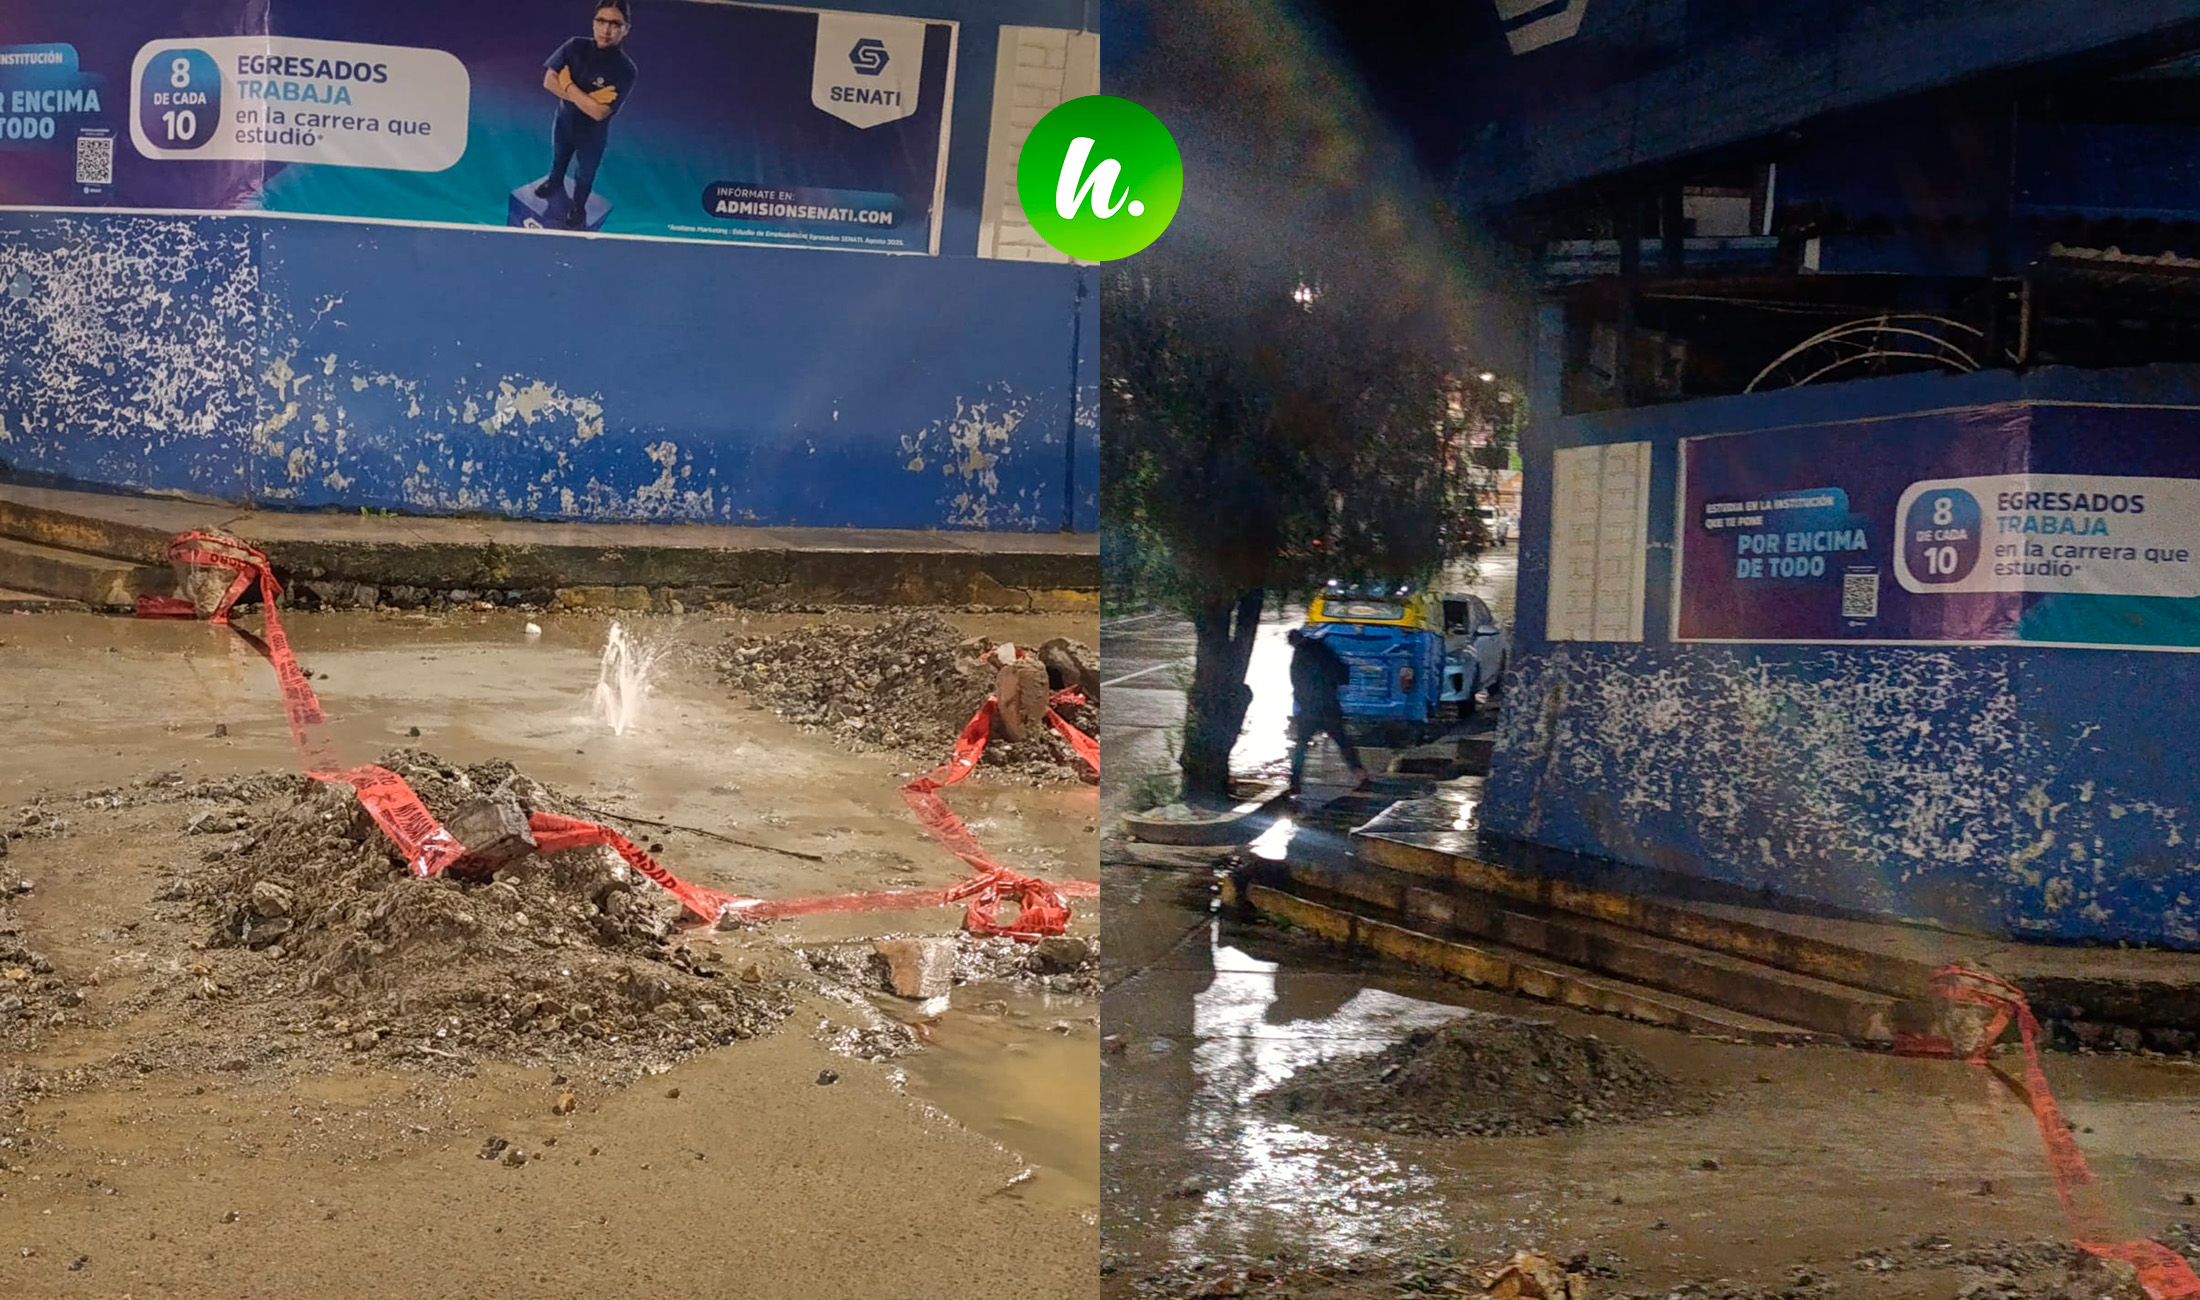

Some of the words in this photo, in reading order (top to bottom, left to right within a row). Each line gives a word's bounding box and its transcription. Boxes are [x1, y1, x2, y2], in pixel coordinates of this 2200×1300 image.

[171, 58, 190, 88] 8
[238, 55, 388, 84] EGRESADOS
[12, 89, 101, 113] ENCIMA
[153, 92, 169, 105] DE
[172, 92, 207, 105] CADA
[237, 80, 352, 106] TRABAJA
[830, 86, 901, 107] SENATI
[0, 116, 56, 139] TODO
[162, 110, 197, 140] 10
[236, 109, 258, 124] en
[266, 107, 285, 125] la
[294, 112, 379, 132] carrera
[388, 119, 432, 136] que
[717, 187, 776, 200] INFÓRMATE
[779, 191, 796, 202] EN:
[715, 200, 893, 225] ADMISIONSENATI.COM
[1745, 501, 1758, 511] EN
[1760, 500, 1772, 511] LA
[1933, 497, 1952, 525] 8
[1997, 492, 2144, 514] EGRESADOS
[1916, 531, 1933, 542] DE
[1935, 529, 1968, 542] CADA
[1997, 516, 2109, 537] TRABAJA
[1737, 533, 1780, 554] POR
[1786, 529, 1868, 553] ENCIMA
[1995, 544, 2018, 557] en
[2024, 541, 2043, 557] la
[2051, 545, 2136, 561] carrera
[2145, 547, 2189, 564] que
[1737, 558, 1763, 579] DE
[1768, 556, 1825, 578] TODO
[1924, 546, 1957, 574] 10
